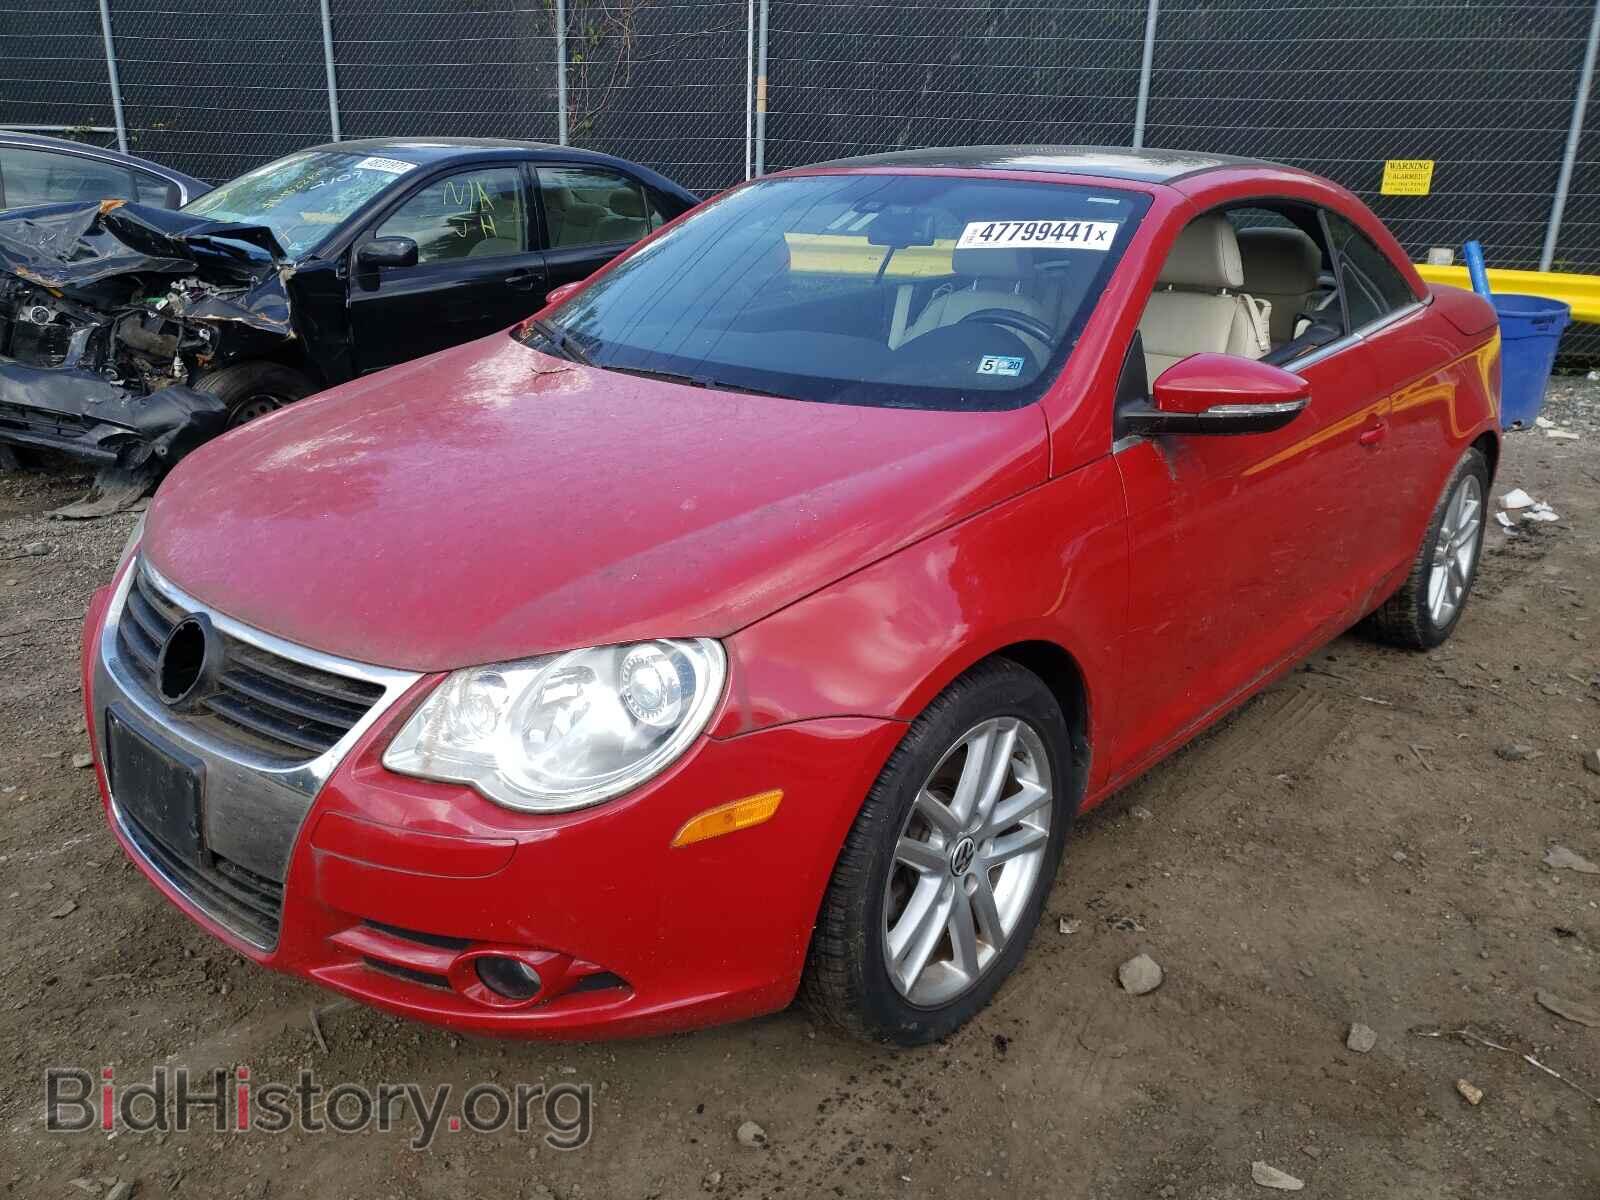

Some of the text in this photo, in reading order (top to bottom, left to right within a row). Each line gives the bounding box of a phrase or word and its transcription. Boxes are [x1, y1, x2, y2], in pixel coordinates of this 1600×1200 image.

[1388, 161, 1431, 170] WARNING
[979, 222, 1094, 242] 47799441
[983, 359, 994, 371] 5
